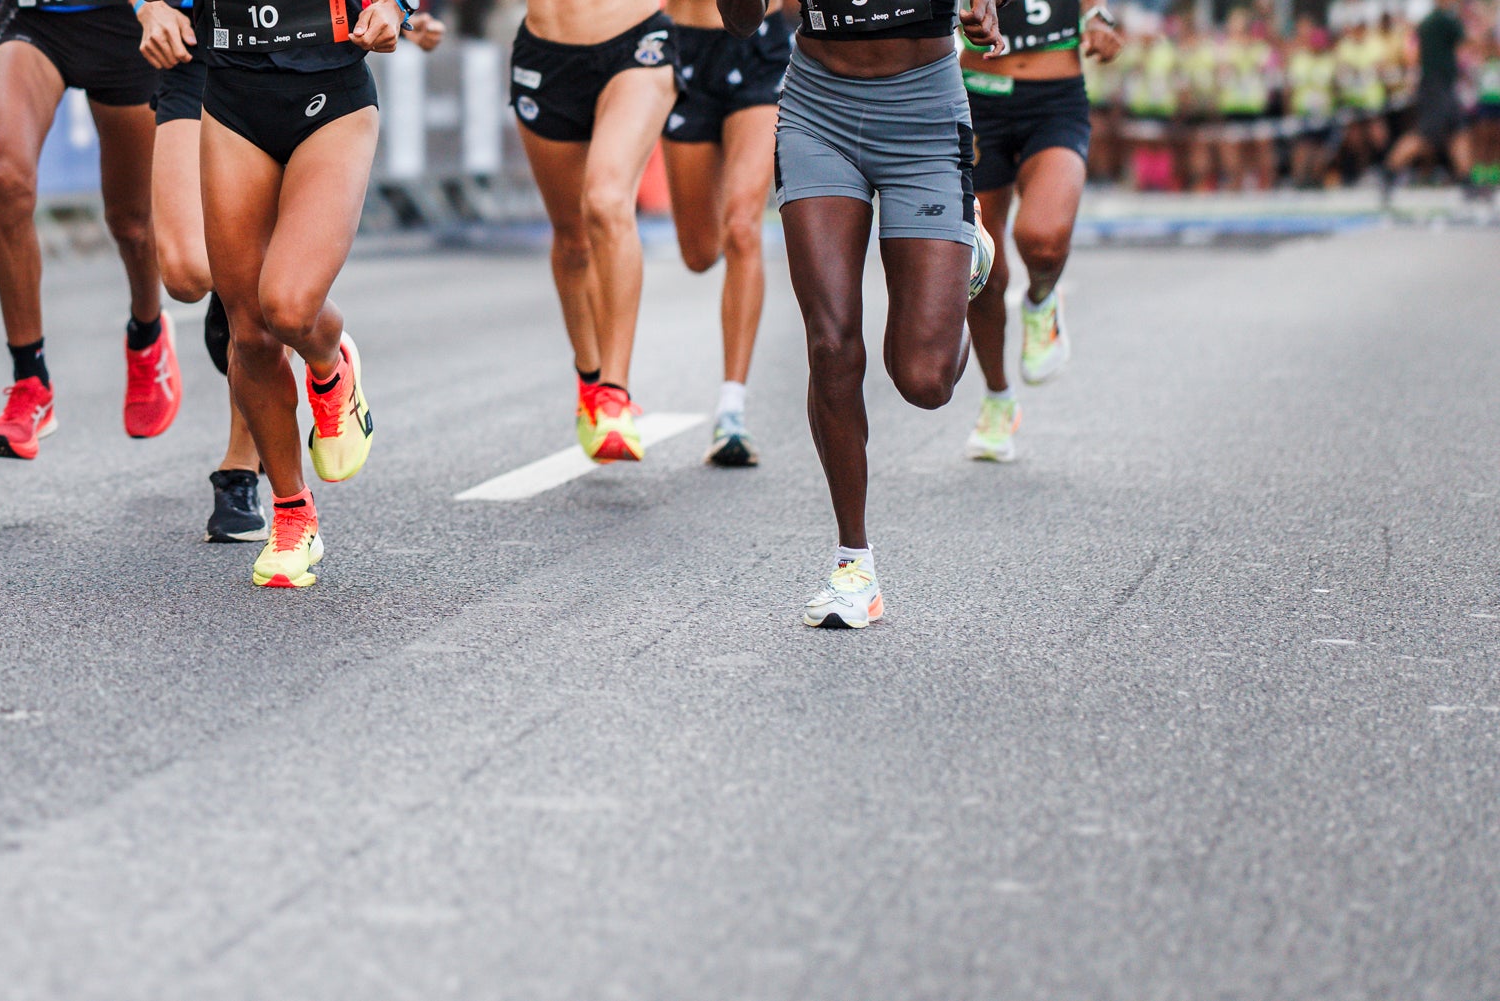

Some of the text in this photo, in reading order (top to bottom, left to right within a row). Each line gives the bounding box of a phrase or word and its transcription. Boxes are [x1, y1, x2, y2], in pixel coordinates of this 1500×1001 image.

[247, 4, 279, 29] 10
[871, 13, 889, 21] Jeep
[273, 35, 291, 43] Jeep
